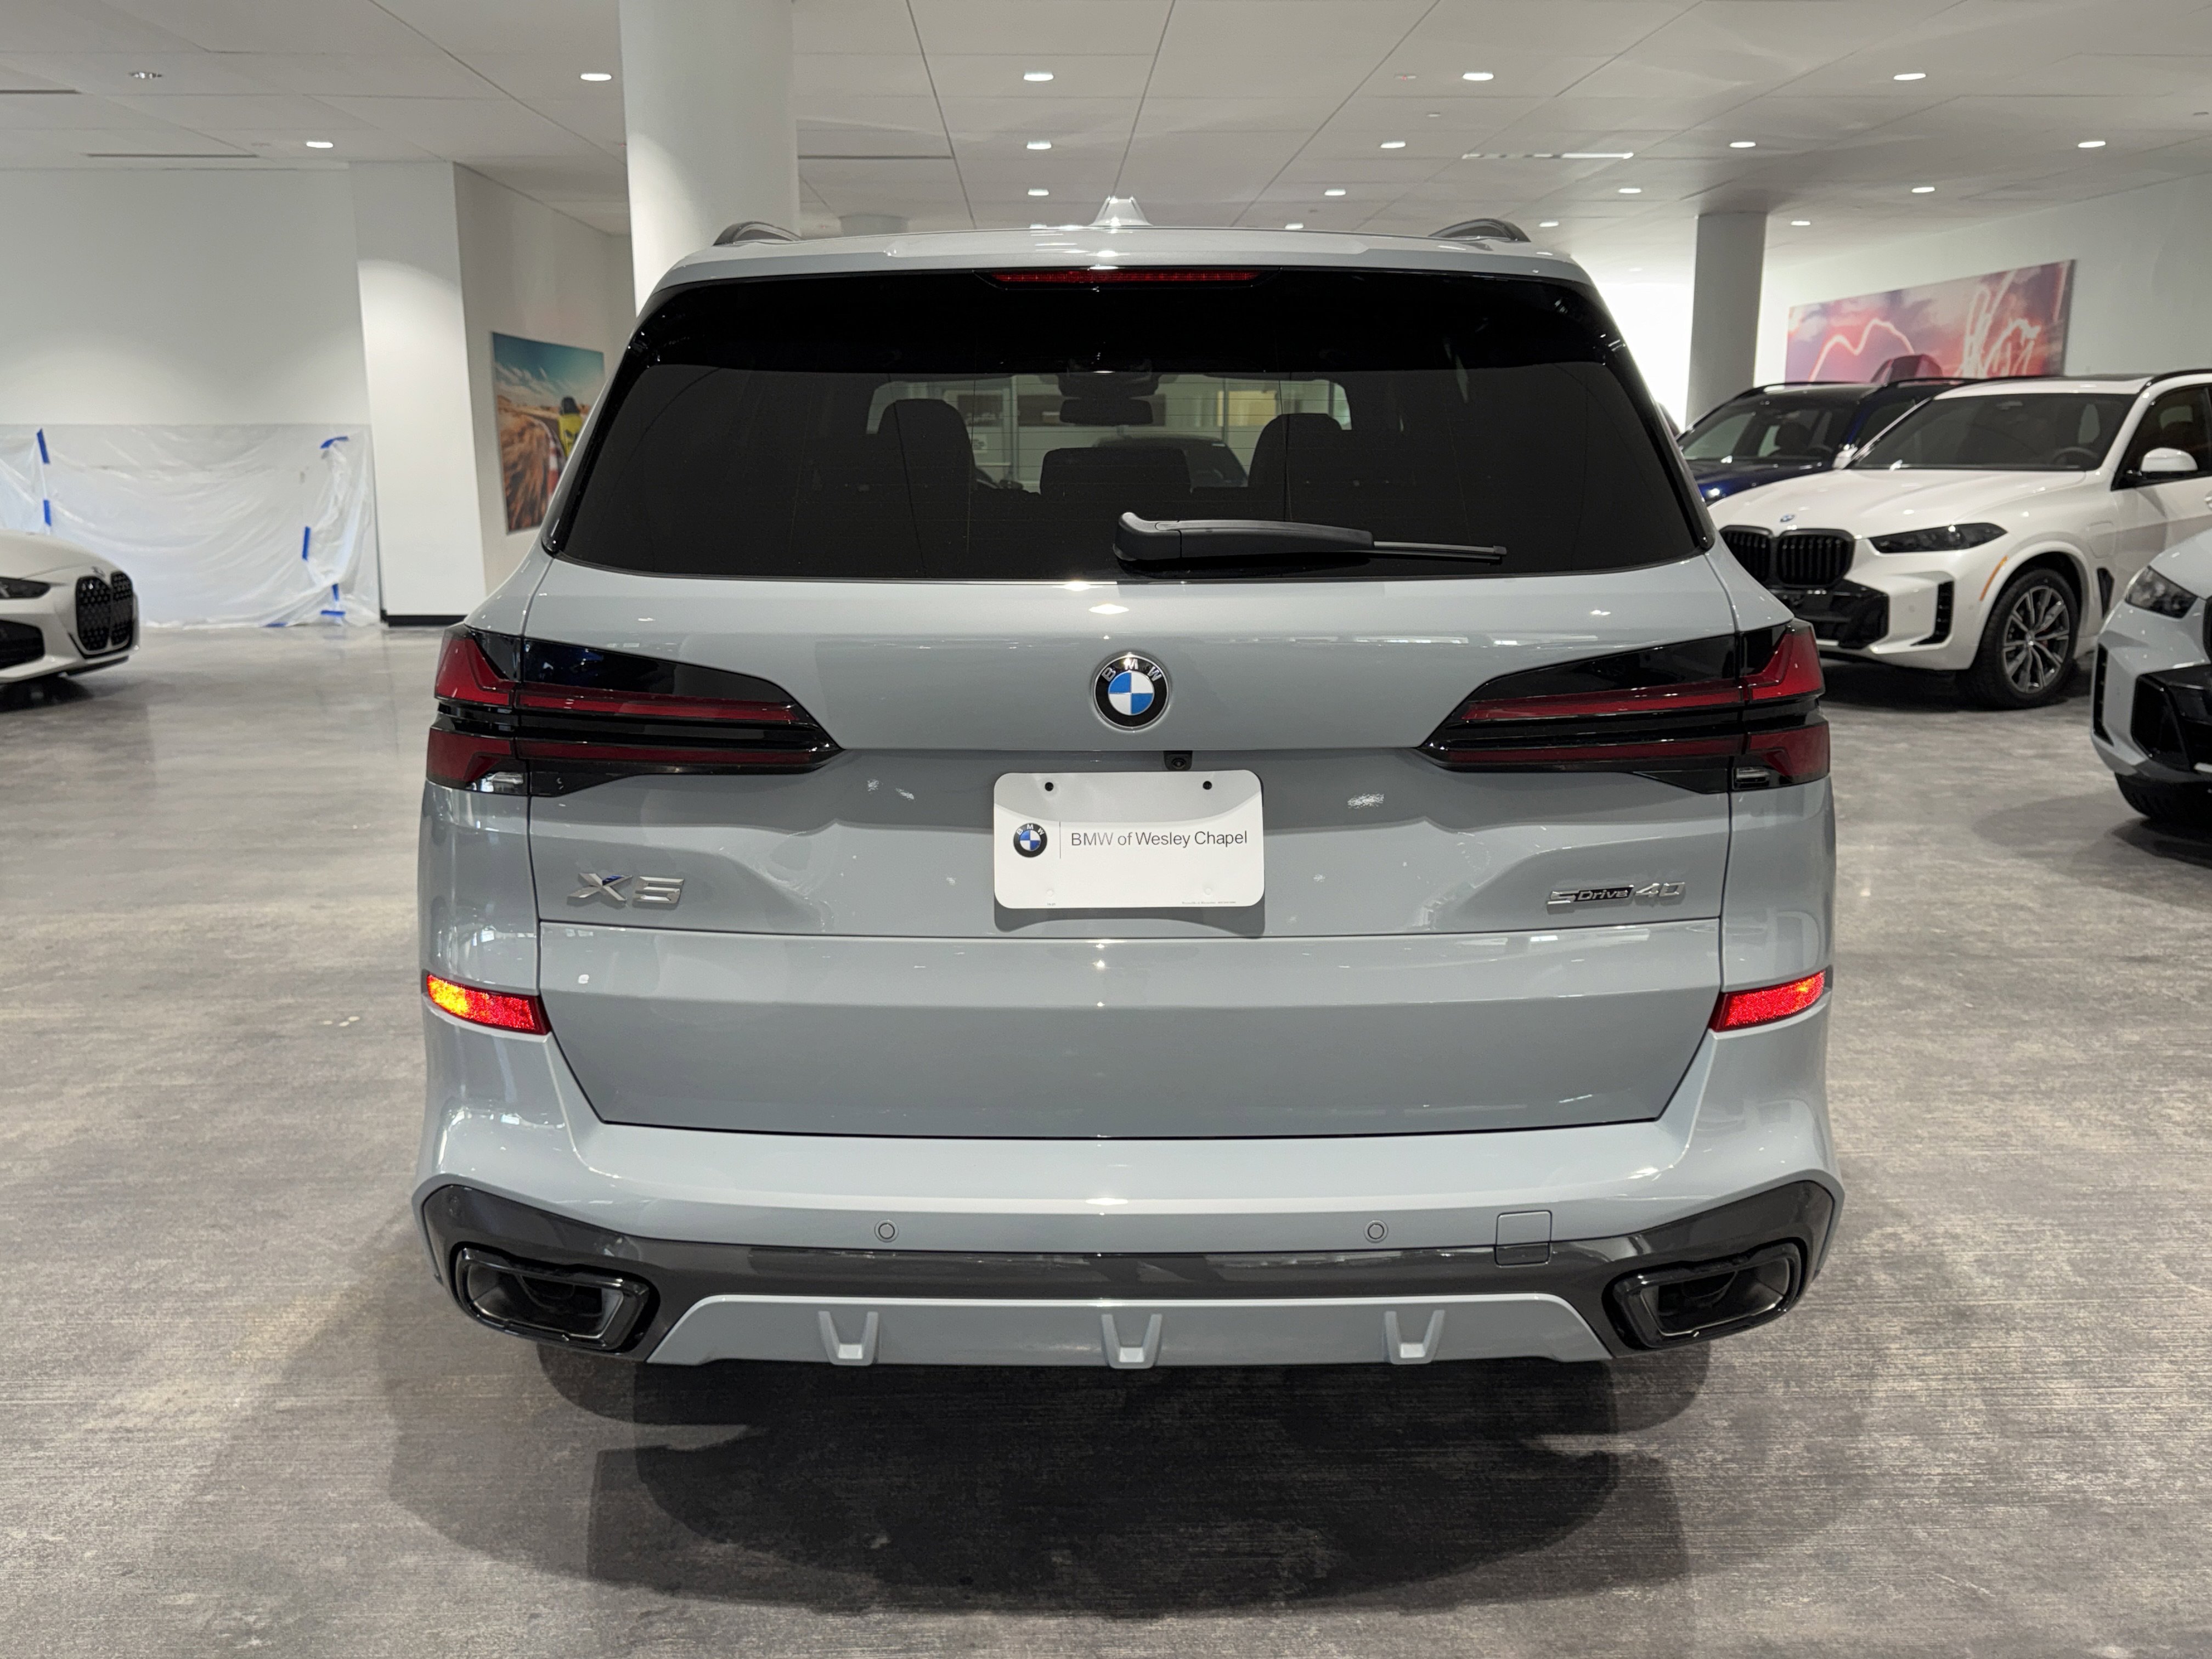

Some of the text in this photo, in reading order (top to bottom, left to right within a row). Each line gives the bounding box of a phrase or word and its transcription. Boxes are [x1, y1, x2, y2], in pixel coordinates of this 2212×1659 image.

[1101, 658, 1163, 682] BMW
[1016, 824, 1045, 836] BMW
[1071, 830, 1247, 849] BMW of Wesley Chapel
[568, 873, 685, 904] X5
